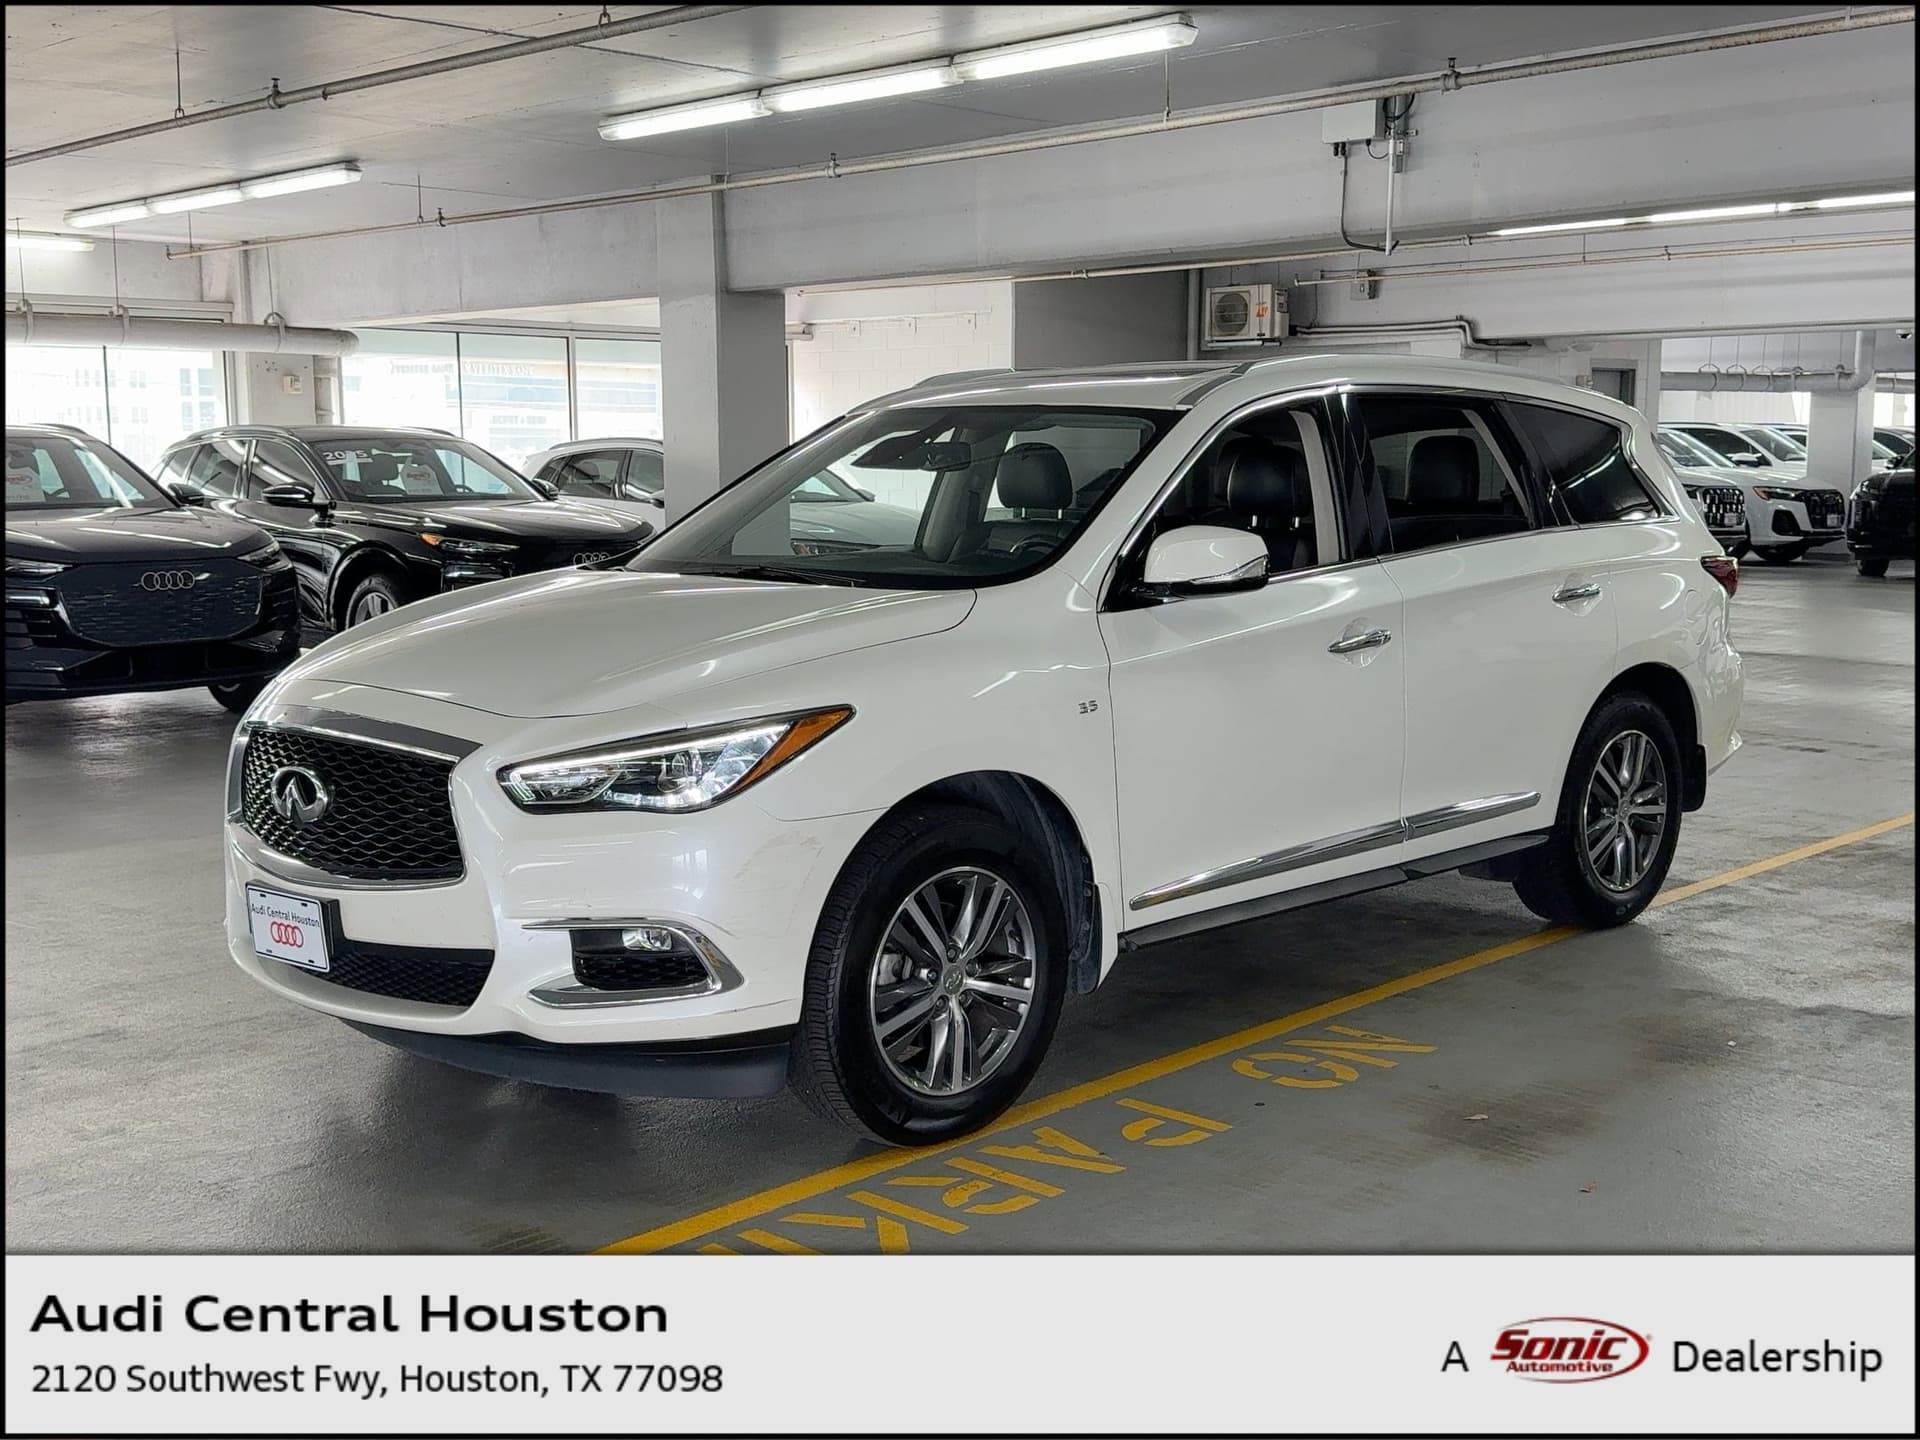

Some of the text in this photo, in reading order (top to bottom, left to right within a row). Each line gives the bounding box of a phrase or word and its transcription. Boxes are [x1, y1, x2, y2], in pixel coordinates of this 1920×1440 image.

[322, 450, 368, 460] 205
[251, 903, 320, 928] Audi Central Houston
[695, 1024, 1438, 1254] NO PARKI
